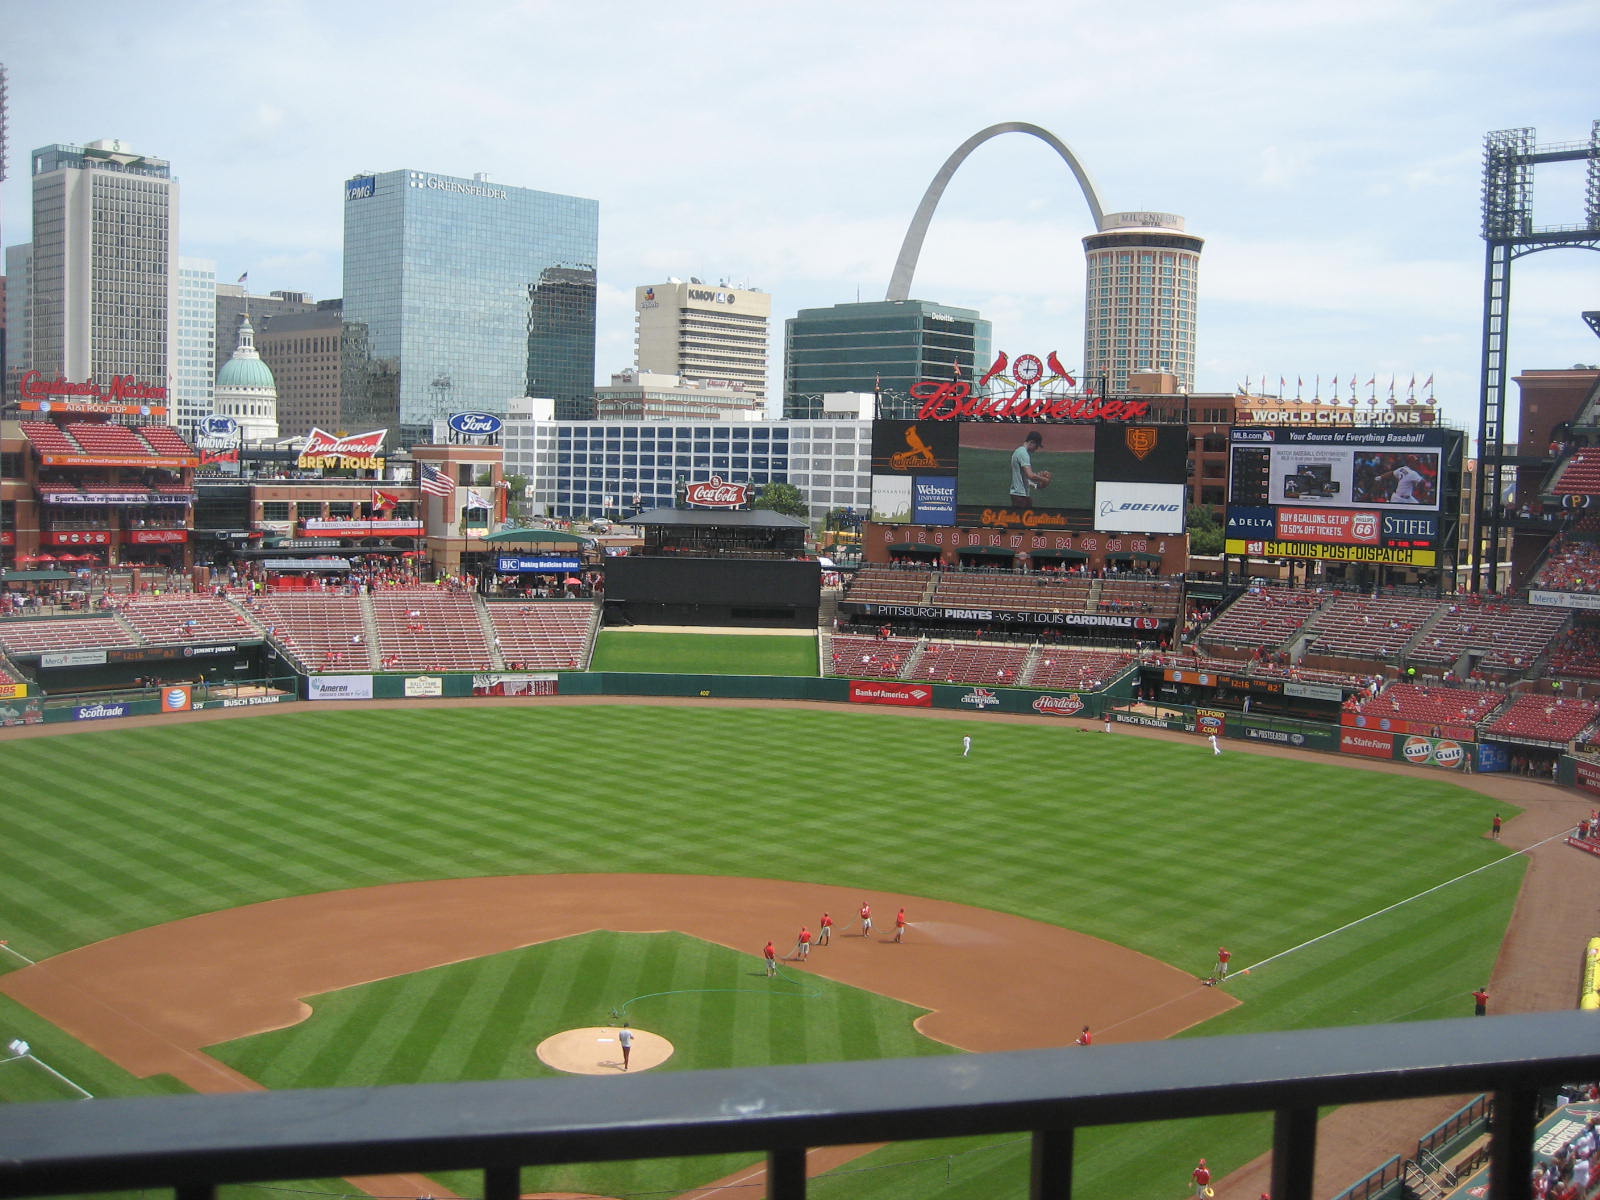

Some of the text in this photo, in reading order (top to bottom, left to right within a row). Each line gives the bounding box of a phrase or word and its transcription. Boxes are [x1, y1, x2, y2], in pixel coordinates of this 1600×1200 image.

[345, 185, 371, 200] KPMG
[688, 289, 715, 302] KMOV
[20, 370, 168, 402] Cardinals Nation
[910, 381, 1150, 420] Budweiser
[65, 404, 127, 413] AT&T ROOFTOP
[461, 414, 492, 430] Ford
[1251, 410, 1420, 424] WORLD CHAMPIONS
[208, 418, 230, 430] FOX
[1233, 432, 1262, 440] MLB.com
[1289, 432, 1425, 444] Your Source for Everything Baseball!
[196, 437, 242, 449] MIDWEST
[303, 437, 385, 454] Budweiser
[299, 456, 386, 470] BREW HOUSE
[694, 485, 738, 502] Coca-Cola
[916, 484, 955, 496] Webster
[1120, 502, 1180, 512] BOEING
[1239, 518, 1273, 527] DELTA
[1280, 512, 1293, 522] BUY
[1298, 513, 1327, 524] GALLONS.
[1327, 515, 1340, 524] GET
[1340, 516, 1349, 525] UP
[1280, 524, 1343, 537] TO 50% OFF TICKETS.
[1356, 524, 1373, 535] 66
[1383, 516, 1435, 536] STIFEL
[905, 531, 910, 543] 1
[917, 531, 926, 544] 2
[934, 532, 943, 545] 6
[951, 533, 960, 545] 9
[968, 533, 981, 546] 10
[989, 534, 1001, 547] 14
[1010, 535, 1023, 548] 17
[1031, 536, 1047, 549] 20
[1055, 537, 1072, 550] 24
[1080, 538, 1097, 551] 42
[1105, 539, 1122, 552] 45
[1267, 541, 1283, 555] ST.
[1285, 542, 1318, 557] LOUIS
[1321, 543, 1413, 563] POST-DISPATCH
[501, 560, 517, 569] BJC
[520, 561, 539, 569] Making
[878, 605, 942, 618] PITTSBURGH
[944, 608, 993, 620] PIRATES
[1017, 612, 1031, 622] ST.
[1034, 612, 1064, 624] LOUIS
[1065, 614, 1132, 627] CARDINALS
[194, 647, 214, 655] JIMMY
[44, 656, 65, 666] Mercy
[320, 684, 348, 693] Ameren
[855, 688, 909, 699] Bank of America
[223, 696, 280, 707] BUSCH STADIUM
[960, 697, 1000, 705] CHAMPIONS
[79, 705, 124, 719] Scottrade
[1116, 714, 1168, 728] BUSCH STADIUM
[1203, 719, 1217, 727] Ford
[1353, 737, 1391, 750] State Farm
[1404, 745, 1432, 755] Gulf
[1435, 748, 1462, 760] Gulf
